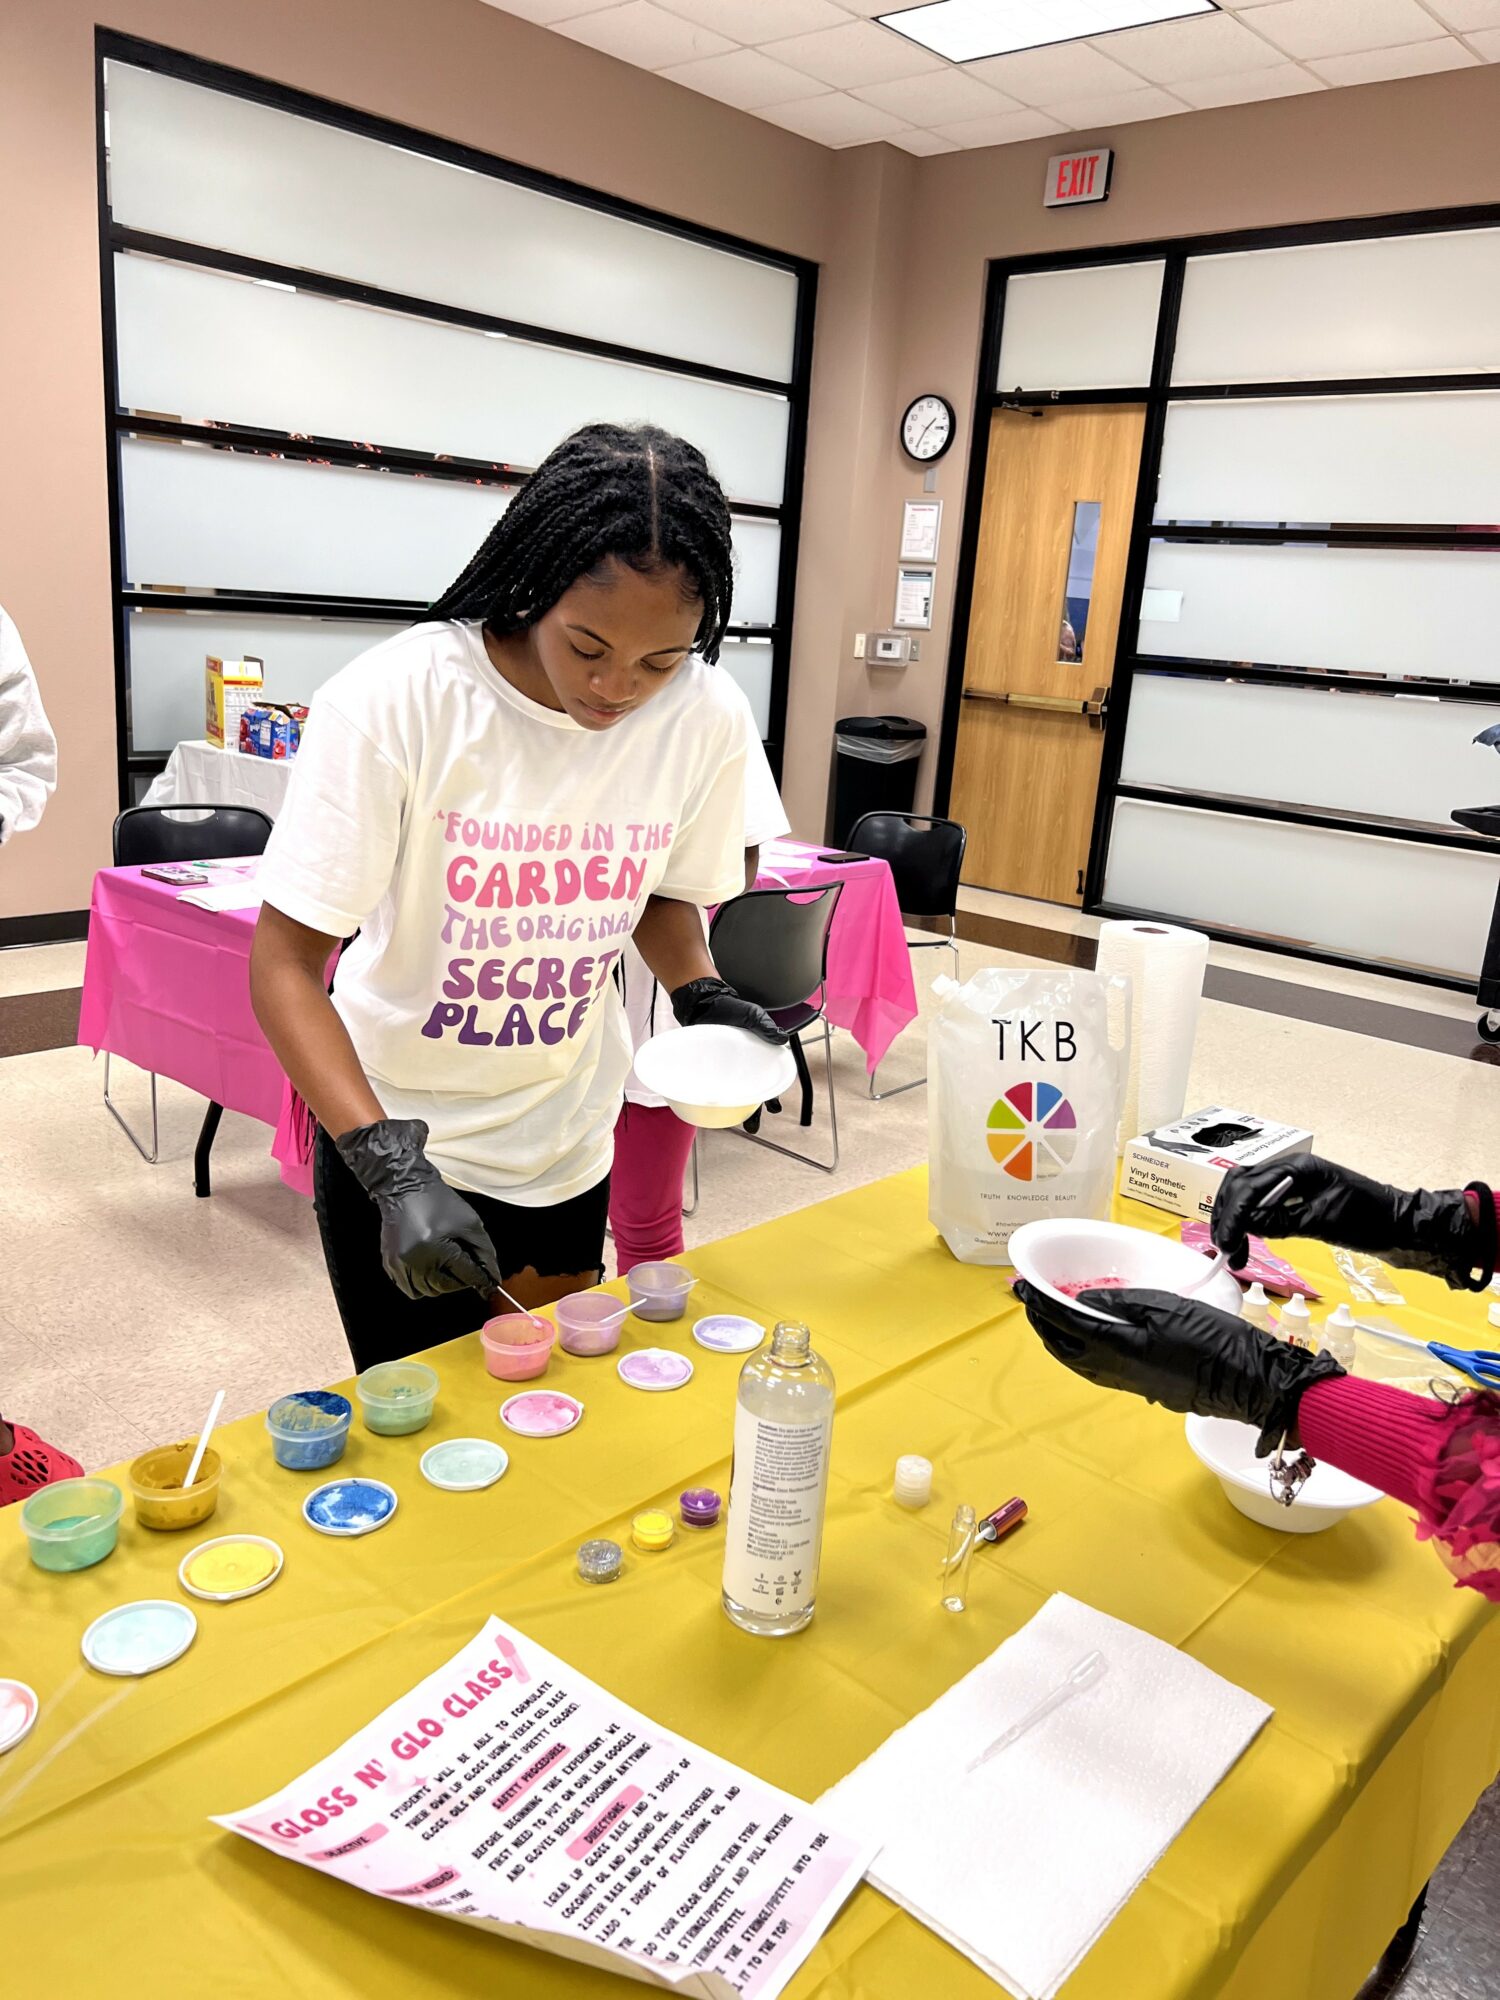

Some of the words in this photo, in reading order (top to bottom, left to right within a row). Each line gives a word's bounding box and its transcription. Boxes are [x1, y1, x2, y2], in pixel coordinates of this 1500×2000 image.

[1056, 155, 1100, 198] EXIT
[626, 822, 673, 852] THE
[441, 903, 512, 950] THE
[442, 949, 619, 1000] SECRET
[992, 1019, 1076, 1061] TKB
[1129, 1177, 1149, 1189] Exam
[1152, 1184, 1177, 1199] Gloves
[1130, 1167, 1149, 1178] Vinyl
[1151, 1173, 1186, 1190] Synthetic
[1132, 1153, 1169, 1169] SCHNEIDER
[1206, 1196, 1212, 1204] S
[271, 1786, 358, 1839] GLOSS
[354, 1759, 387, 1789] N'
[391, 1718, 443, 1760] GLO
[442, 1659, 512, 1718] CLASS
[390, 1785, 432, 1820] STUDENTS
[434, 1767, 455, 1784] WILL
[457, 1753, 471, 1764] BE
[474, 1733, 493, 1751] ABLE
[496, 1720, 509, 1731] TO
[511, 1681, 553, 1717] FORMULATE
[405, 1807, 431, 1830] THEIR
[430, 1791, 452, 1810] OWN
[454, 1781, 463, 1793] LIP
[464, 1759, 489, 1781] GLOSS
[488, 1741, 511, 1760] USING
[510, 1719, 535, 1740] VERSA
[535, 1708, 549, 1719] GEL
[548, 1690, 567, 1708] BASE
[450, 1801, 469, 1817] OILS
[469, 1785, 486, 1802] AND
[485, 1754, 522, 1786] PIGMENTS
[472, 1831, 504, 1860] BEFORE
[503, 1795, 543, 1830] BEGINNING
[543, 1776, 562, 1793] THIS
[605, 1723, 620, 1735] WE
[491, 1784, 522, 1810] SAFETY
[521, 1743, 566, 1783] PROCEDURES
[488, 1849, 513, 1871] FIRST
[511, 1830, 533, 1848] NEED
[533, 1819, 547, 1830] TO
[545, 1802, 562, 1819] PUT
[561, 1789, 576, 1801] ON
[574, 1774, 593, 1789] OUR
[589, 1761, 606, 1774] LAB
[506, 1865, 525, 1882] AND
[525, 1836, 556, 1864] GLOVES
[554, 1809, 584, 1837] BEFORE
[581, 1775, 618, 1808] TOUCHING
[570, 1868, 583, 1880] LIP
[584, 1843, 610, 1867] GLOSS
[632, 1801, 648, 1818] AND
[655, 1770, 680, 1793] DROPS
[679, 1758, 691, 1768] OF
[604, 1882, 627, 1903] BASE
[625, 1866, 641, 1883] AND
[640, 1855, 655, 1866] OIL
[652, 1820, 683, 1853] MIXTURE
[681, 1787, 715, 1821] TOGETHER
[621, 1907, 631, 1916] 2
[630, 1880, 656, 1905] DROPS
[657, 1866, 669, 1878] OF
[669, 1818, 711, 1864] FLAVOURING
[711, 1804, 726, 1815] OIL
[725, 1786, 740, 1801] AND
[561, 1883, 597, 1919] COCONUT
[595, 1872, 611, 1883] OIL
[609, 1854, 625, 1871] AND
[625, 1822, 655, 1854] ALMOND
[655, 1917, 679, 1941] YOUR
[676, 1893, 701, 1918] COLOR
[700, 1864, 725, 1893] CHOICE
[721, 1843, 742, 1864] THEN
[678, 1887, 735, 1949] SYRINGE/PIPETTE
[732, 1866, 749, 1885] AND
[750, 1846, 766, 1866] PULL
[763, 1814, 794, 1844] MIXTURE
[724, 1944, 742, 1963] THE
[741, 1877, 795, 1941] SYRINGE/PIPETTE
[792, 1854, 812, 1874] INTO
[810, 1832, 829, 1852] TUBE
[741, 1971, 752, 1986] IT
[748, 1956, 761, 1969] TO
[759, 1936, 776, 1955] THE
